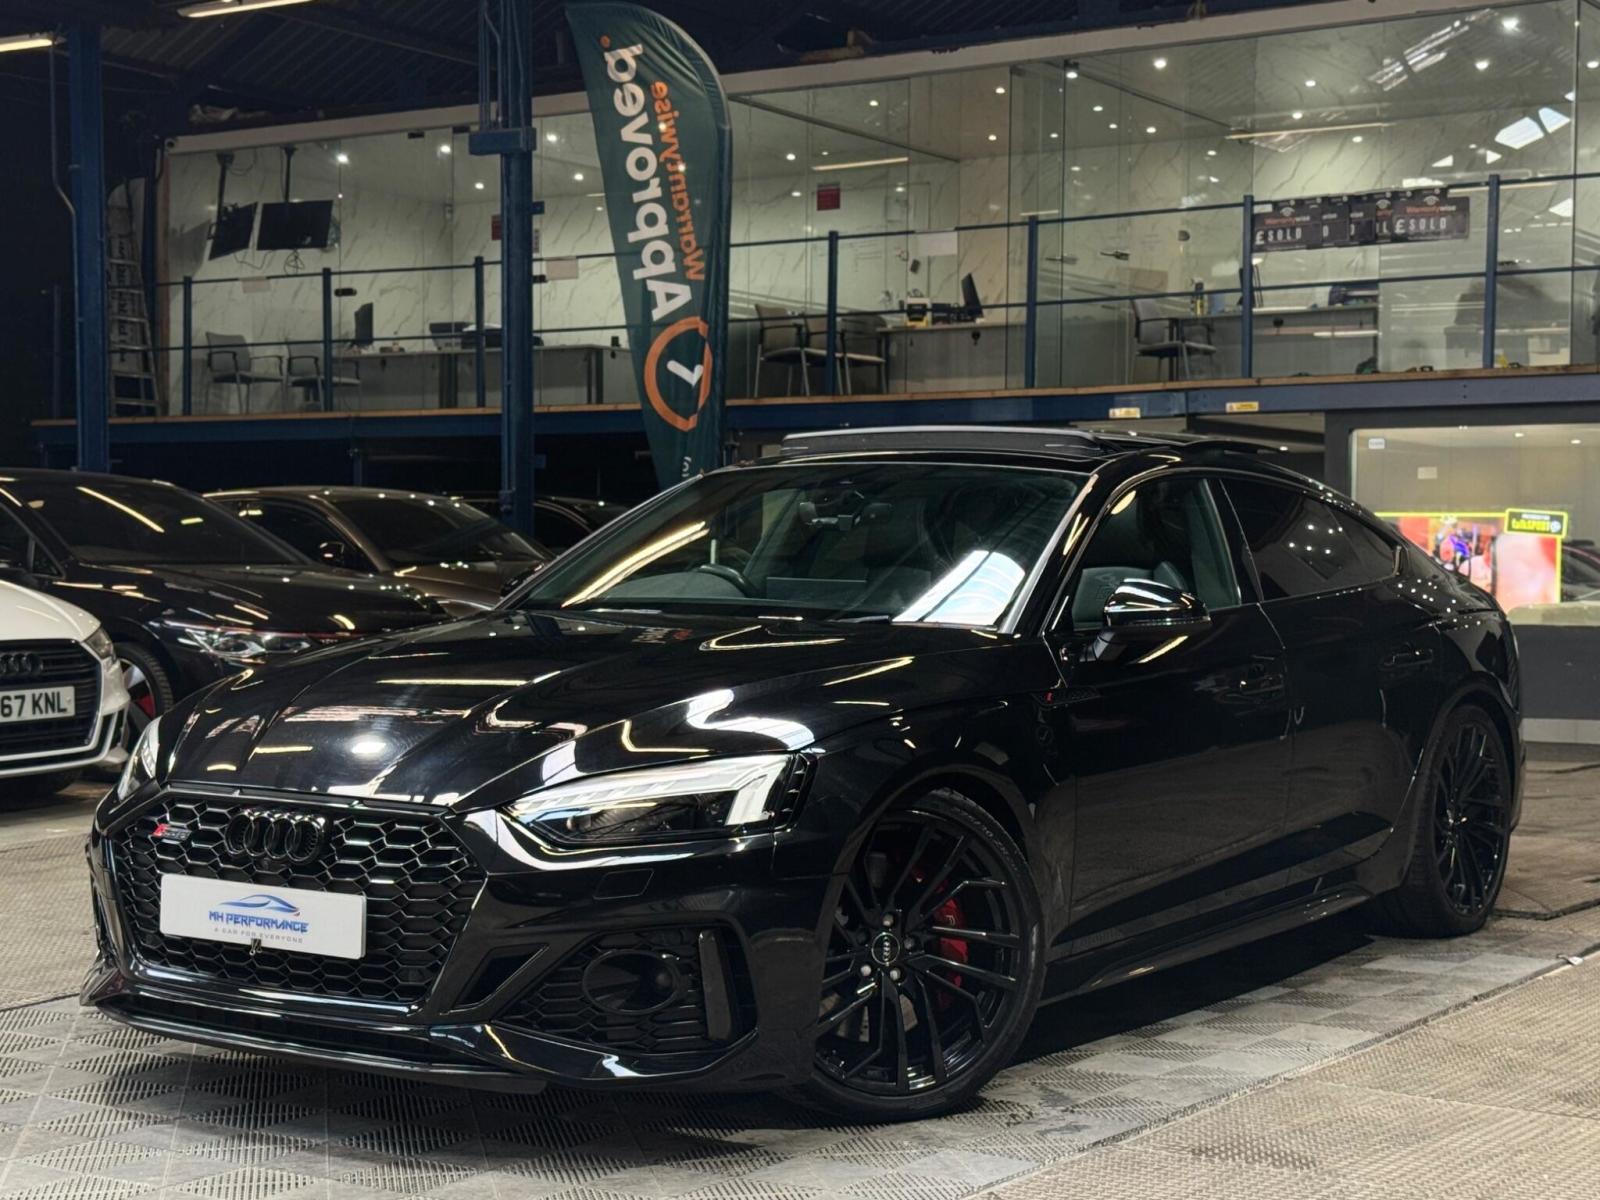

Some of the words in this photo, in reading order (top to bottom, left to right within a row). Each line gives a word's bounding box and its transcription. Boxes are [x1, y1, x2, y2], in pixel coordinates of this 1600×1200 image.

[31, 691, 67, 715] KNL
[208, 910, 225, 922] MH
[225, 913, 309, 933] PERFORMANCE
[259, 933, 304, 943] EVERYONE
